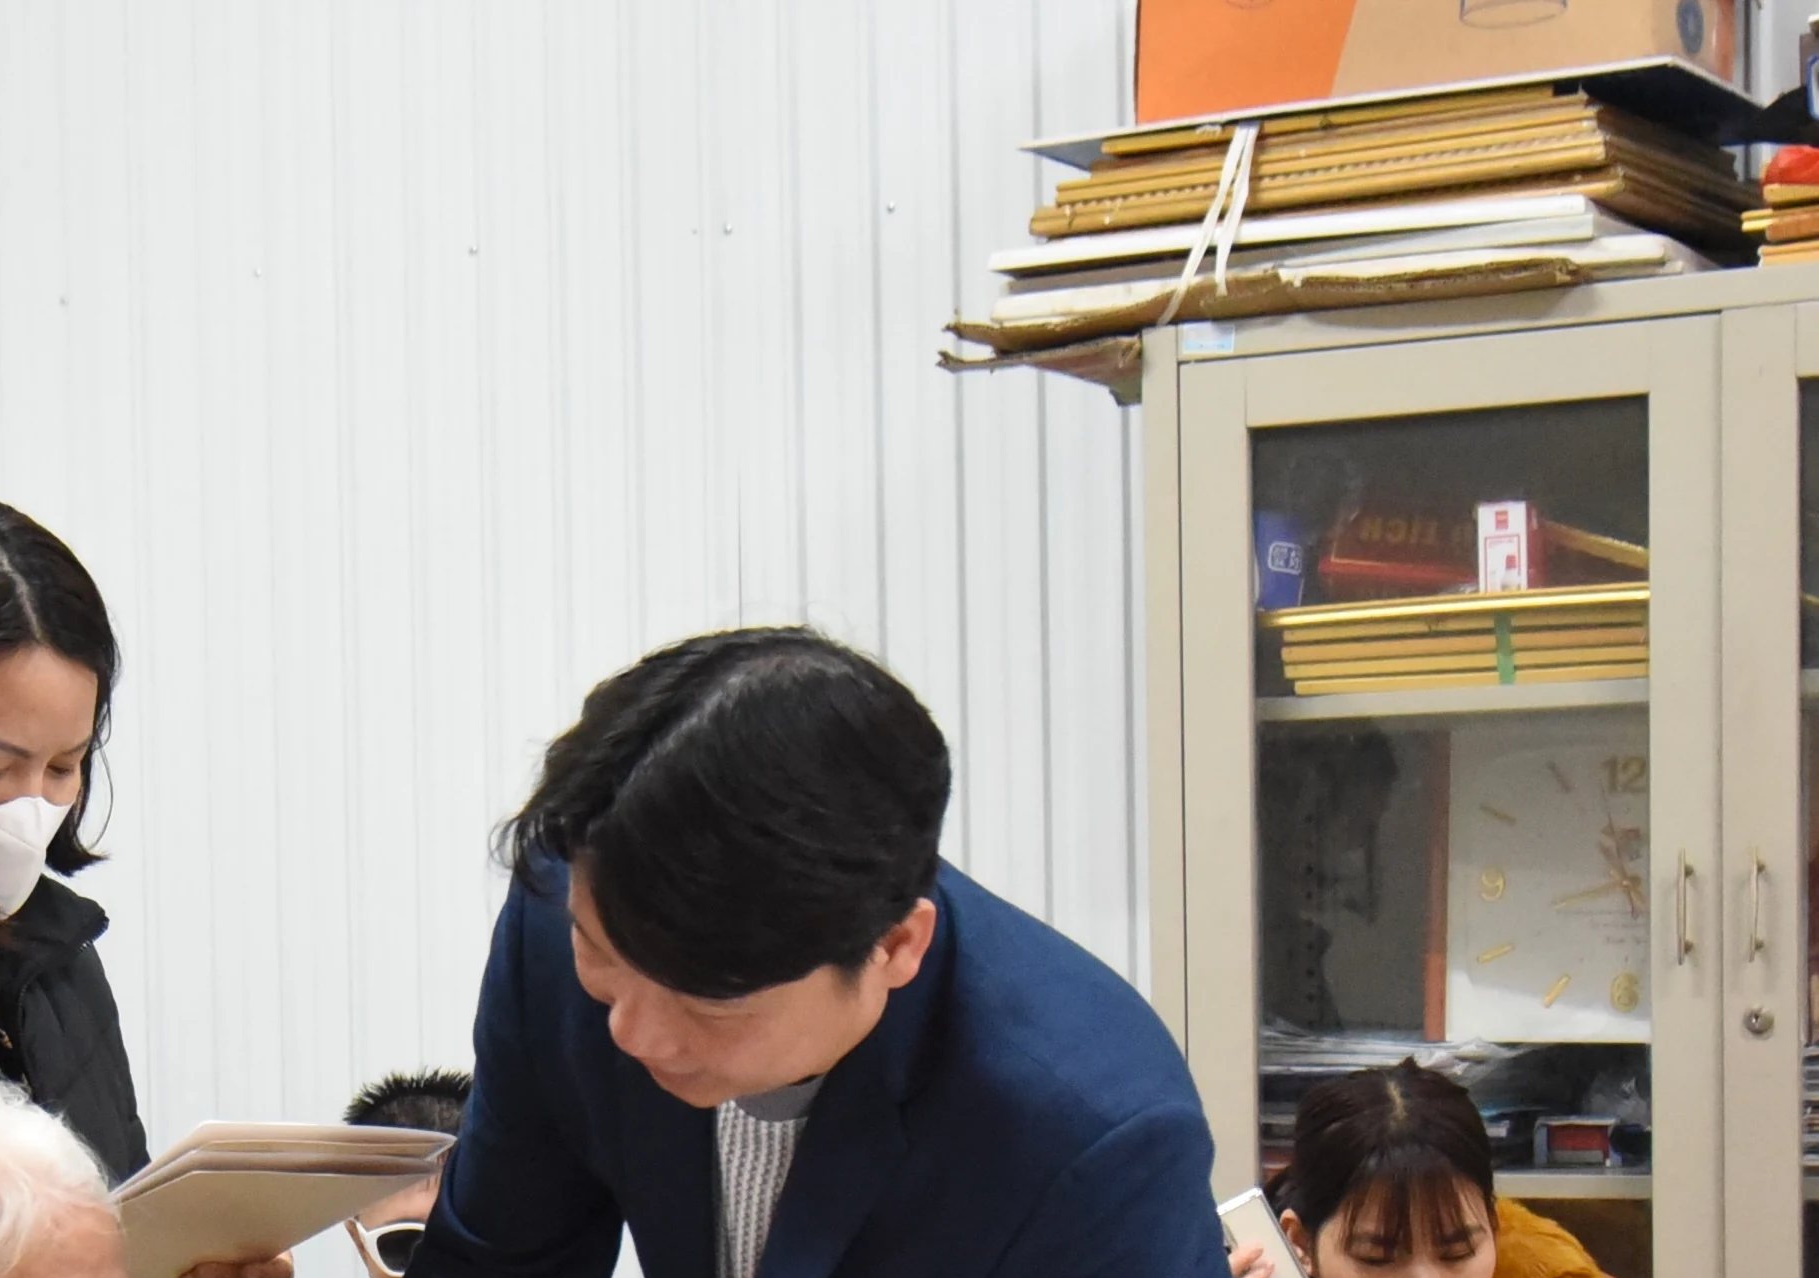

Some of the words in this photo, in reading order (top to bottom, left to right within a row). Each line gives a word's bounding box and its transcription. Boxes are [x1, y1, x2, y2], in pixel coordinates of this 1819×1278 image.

[1600, 755, 1648, 793] 12
[1478, 867, 1507, 902] 9
[1610, 972, 1640, 1014] 6
